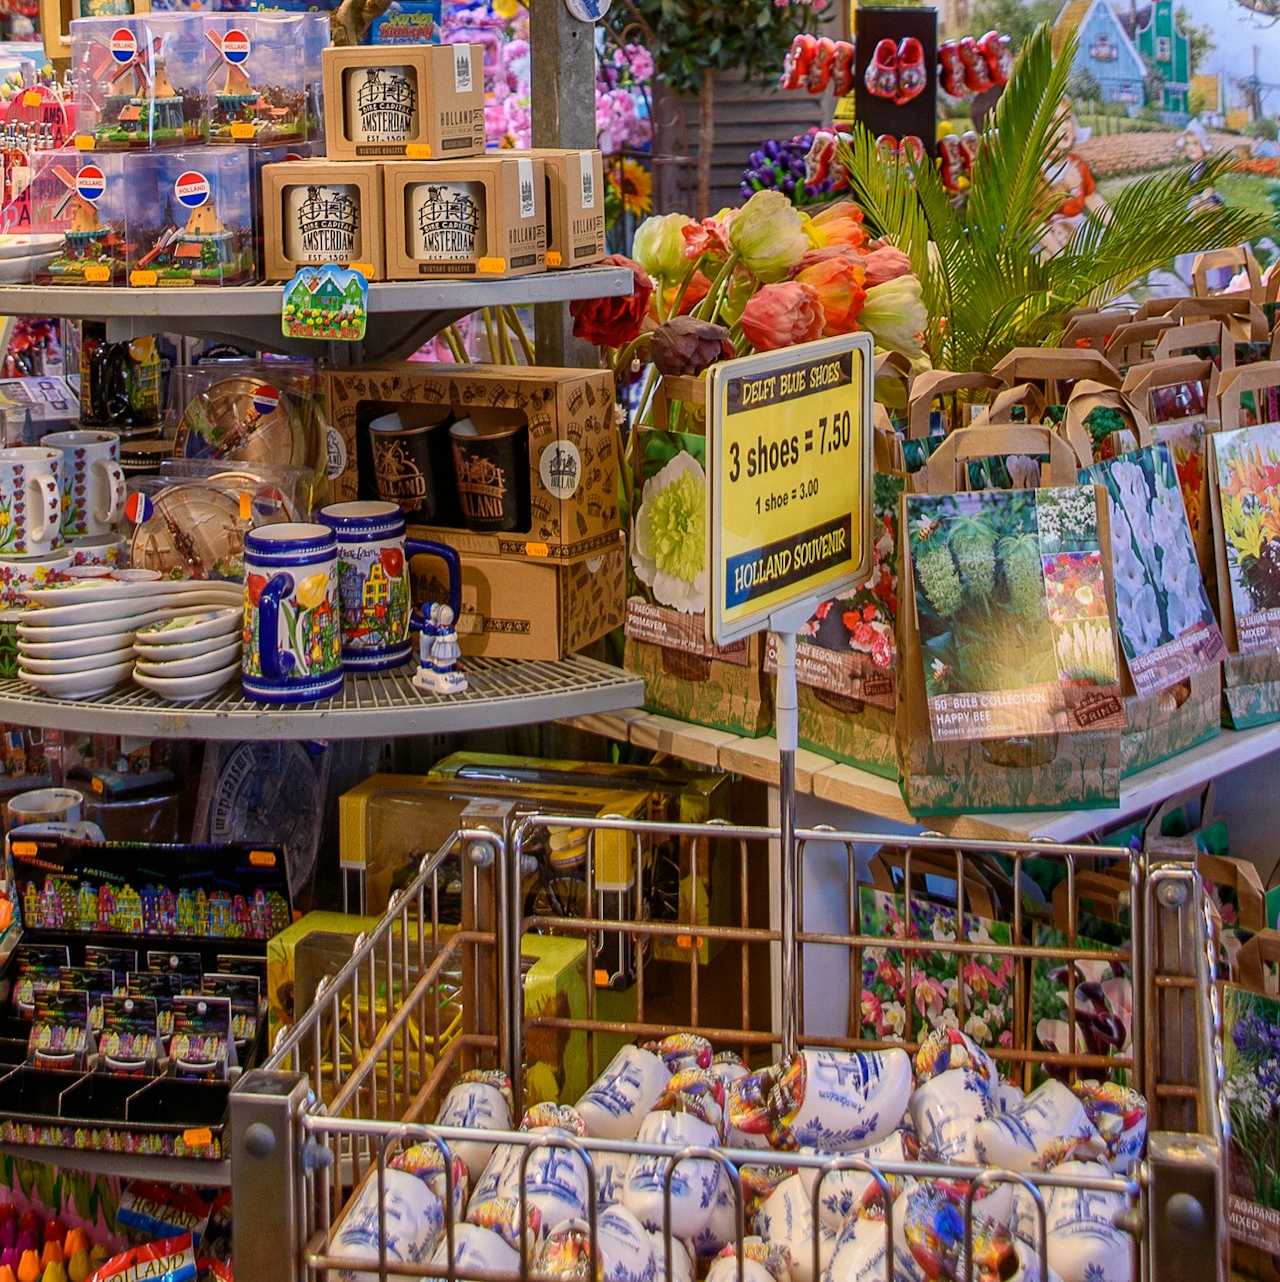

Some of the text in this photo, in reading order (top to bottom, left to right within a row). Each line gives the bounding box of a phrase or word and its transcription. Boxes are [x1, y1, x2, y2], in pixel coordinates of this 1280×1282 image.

[388, 10, 433, 24] Garden
[379, 23, 434, 40] Butterfly
[112, 41, 135, 50] HOLLAND
[224, 42, 248, 50] HOLLAND
[363, 102, 411, 114] BIKE CAPITAL
[361, 112, 412, 132] AMSTERDAM
[440, 110, 473, 126] HOLLAND
[473, 109, 484, 146] MUG
[79, 179, 104, 187] HOLLAND
[178, 184, 206, 194] HOLLAND
[303, 221, 352, 232] BIKE CAPITAL
[424, 223, 475, 233] BIKE CAPITAL
[572, 217, 597, 235] HOLLAND
[302, 229, 354, 251] AMSTERDAM
[423, 231, 475, 252] AMSTERDAM
[508, 226, 537, 245] HOLLAND
[596, 215, 605, 255] MUG
[536, 225, 546, 264] MUG
[288, 325, 360, 340] HOLLAND
[742, 360, 841, 406] DELFT BLUE SHOES
[729, 409, 851, 483] 3 shoes = 7.50
[549, 475, 577, 489] HOLLAND
[755, 478, 819, 515] 1 shoe = 3.00
[136, 495, 144, 522] HOLLAND
[734, 526, 847, 594] HOLLAND SOUVENIR
[629, 602, 661, 619] 1 PAEONIA
[627, 614, 668, 633] PRIMAVERA
[1241, 626, 1267, 639] MIXED
[769, 636, 775, 648] 6
[811, 647, 844, 666] BEGONIA
[803, 658, 828, 675] Mixed
[1134, 660, 1141, 671] 25
[1136, 669, 1156, 684] WHITE
[865, 682, 893, 696] PRINS
[935, 692, 1046, 711] 50 BULB COLLECTION
[936, 710, 991, 725] HAPPY BEE
[1079, 703, 1120, 726] PRINS
[937, 725, 965, 736] Flowers
[214, 747, 253, 830] Amsterdam
[82, 866, 126, 883] AMSTERDAM
[818, 1089, 866, 1114] Amsterdam
[130, 1196, 200, 1229] HOLLAND
[1227, 1211, 1260, 1232] MIXED
